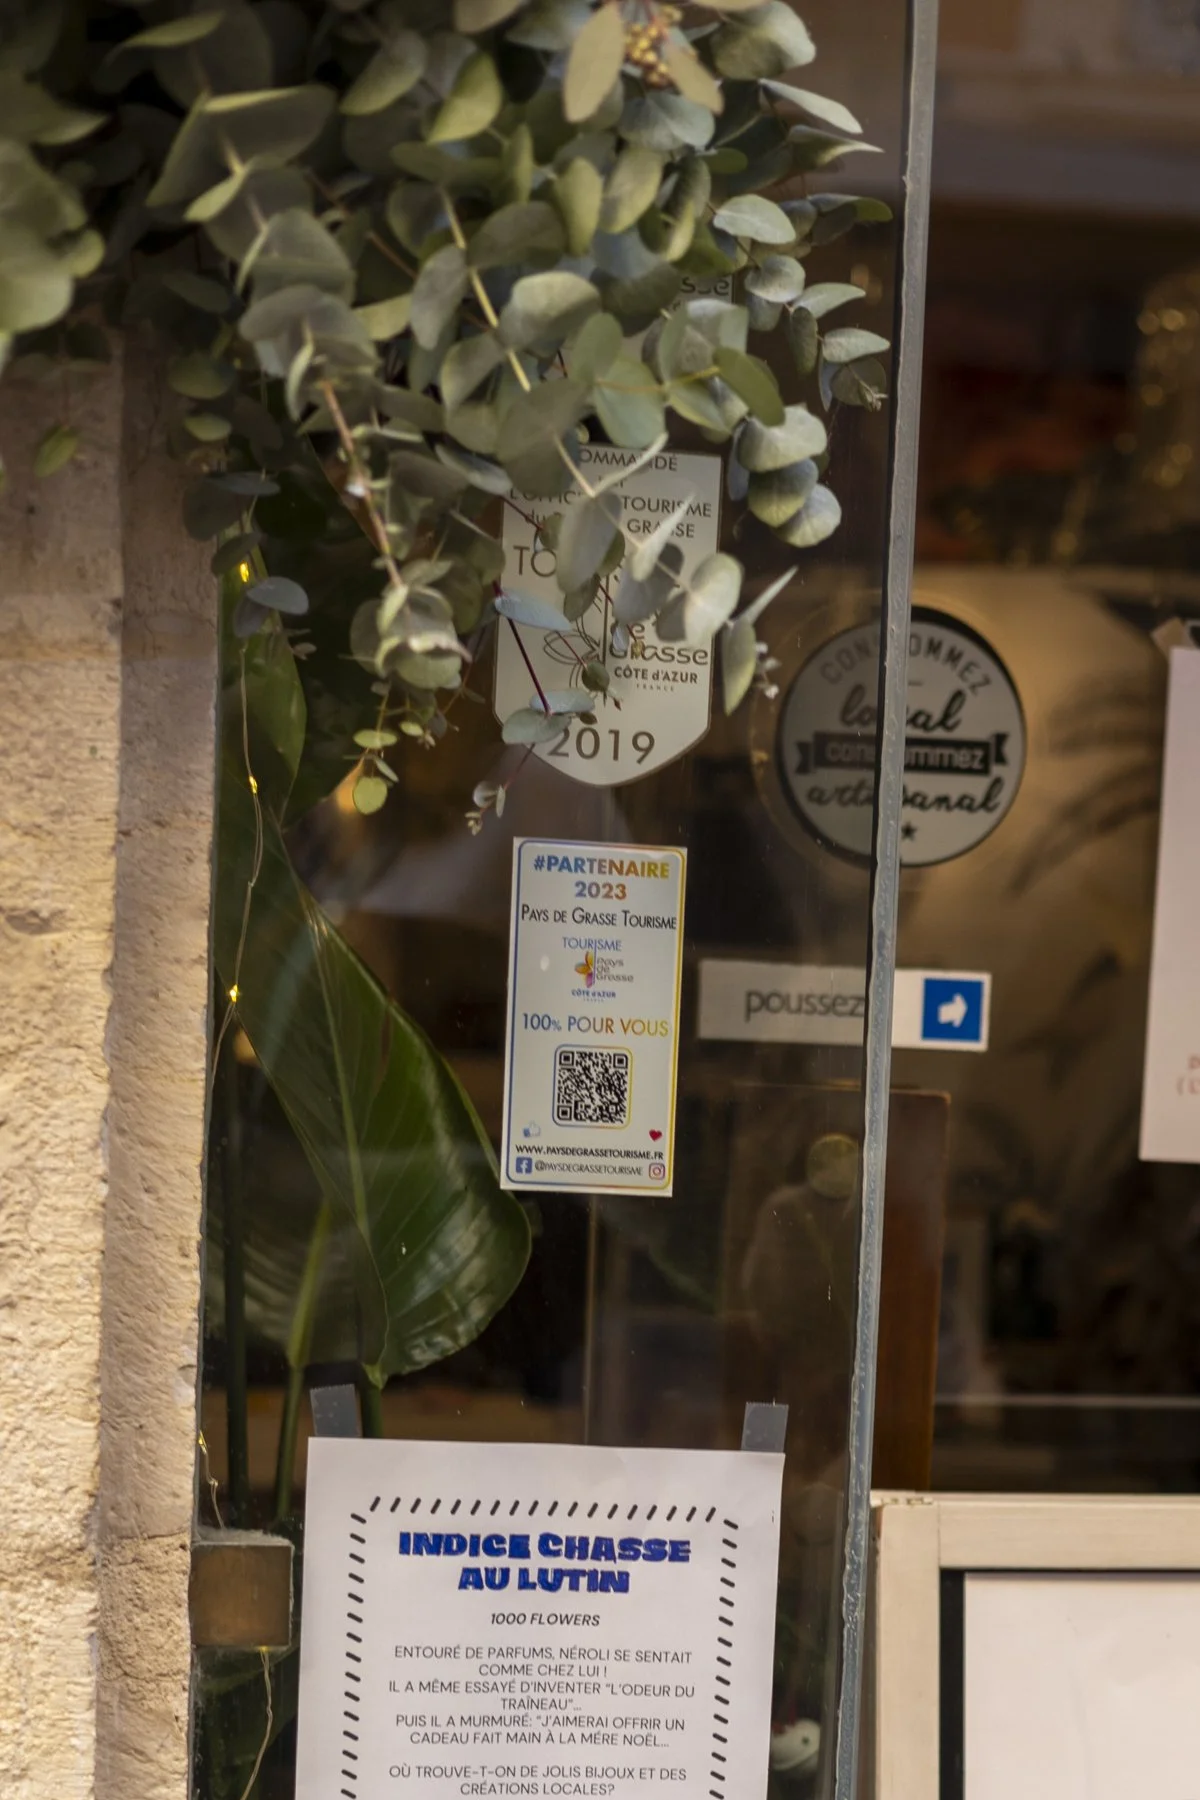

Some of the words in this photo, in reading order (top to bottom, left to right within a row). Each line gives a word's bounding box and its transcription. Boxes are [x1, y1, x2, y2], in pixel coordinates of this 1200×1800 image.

[578, 448, 678, 471] OMMADÉ
[626, 518, 695, 538] GRSE
[614, 664, 648, 678] CÔTE
[652, 670, 698, 684] d'AZUR
[820, 633, 993, 696] CONOMMEZ
[840, 684, 966, 733] loal
[548, 727, 655, 765] 2019
[826, 742, 986, 769] conmmez
[806, 775, 1005, 813] artanal
[533, 855, 670, 879] #PARTENAIRE
[575, 880, 627, 900] 2023
[562, 937, 622, 951] TOURISME
[744, 990, 865, 1022] poussez
[523, 1013, 562, 1031] 100%
[568, 1016, 614, 1034] POUR
[620, 1019, 668, 1037] VOUS
[398, 1531, 531, 1560] INDICE
[537, 1532, 692, 1564] CHASSE
[457, 1566, 511, 1591] AU
[517, 1567, 630, 1594] LUTIN
[491, 1612, 527, 1625] 1000
[530, 1612, 601, 1627] FLOWERS
[394, 1644, 461, 1660] ENTOURÉ
[465, 1646, 483, 1660] DE
[487, 1646, 554, 1662] PARFUMS,
[559, 1645, 610, 1661] NÉROLI
[613, 1648, 631, 1662] SE
[634, 1650, 692, 1664] SENTAIT
[478, 1663, 533, 1677] COMME
[537, 1663, 575, 1677] CHEZ
[578, 1664, 600, 1678] LUI
[603, 1665, 607, 1678] !
[388, 1680, 400, 1693] IL
[404, 1680, 415, 1693] A
[418, 1678, 460, 1694] MÊME
[464, 1679, 516, 1694] ESSAYÉ
[520, 1681, 601, 1694] D'INVENTER
[605, 1683, 671, 1697] "L'ODEUR
[674, 1685, 695, 1698] DU
[395, 1714, 427, 1728] PUIS
[430, 1715, 441, 1728] IL
[446, 1715, 456, 1728] A
[459, 1713, 533, 1728] MURMURÉ:
[536, 1715, 609, 1729] "J'AIMERAI
[612, 1716, 661, 1730] OFFRIR
[665, 1718, 685, 1731] UN
[409, 1731, 470, 1745] CADEAU
[473, 1731, 502, 1744] FAIT
[506, 1731, 542, 1744] MAIN
[545, 1729, 555, 1744] À
[559, 1732, 577, 1745] LA
[388, 1765, 411, 1778] OÙ
[415, 1765, 517, 1779] TROUVE-T-ON
[520, 1765, 538, 1778] DE
[542, 1765, 581, 1778] JOLIS
[585, 1766, 635, 1780] BIJOUX
[639, 1767, 656, 1780] ET
[659, 1767, 687, 1781] DES
[459, 1780, 539, 1796] CRÉATIONS
[542, 1782, 615, 1796] LOCALES?
